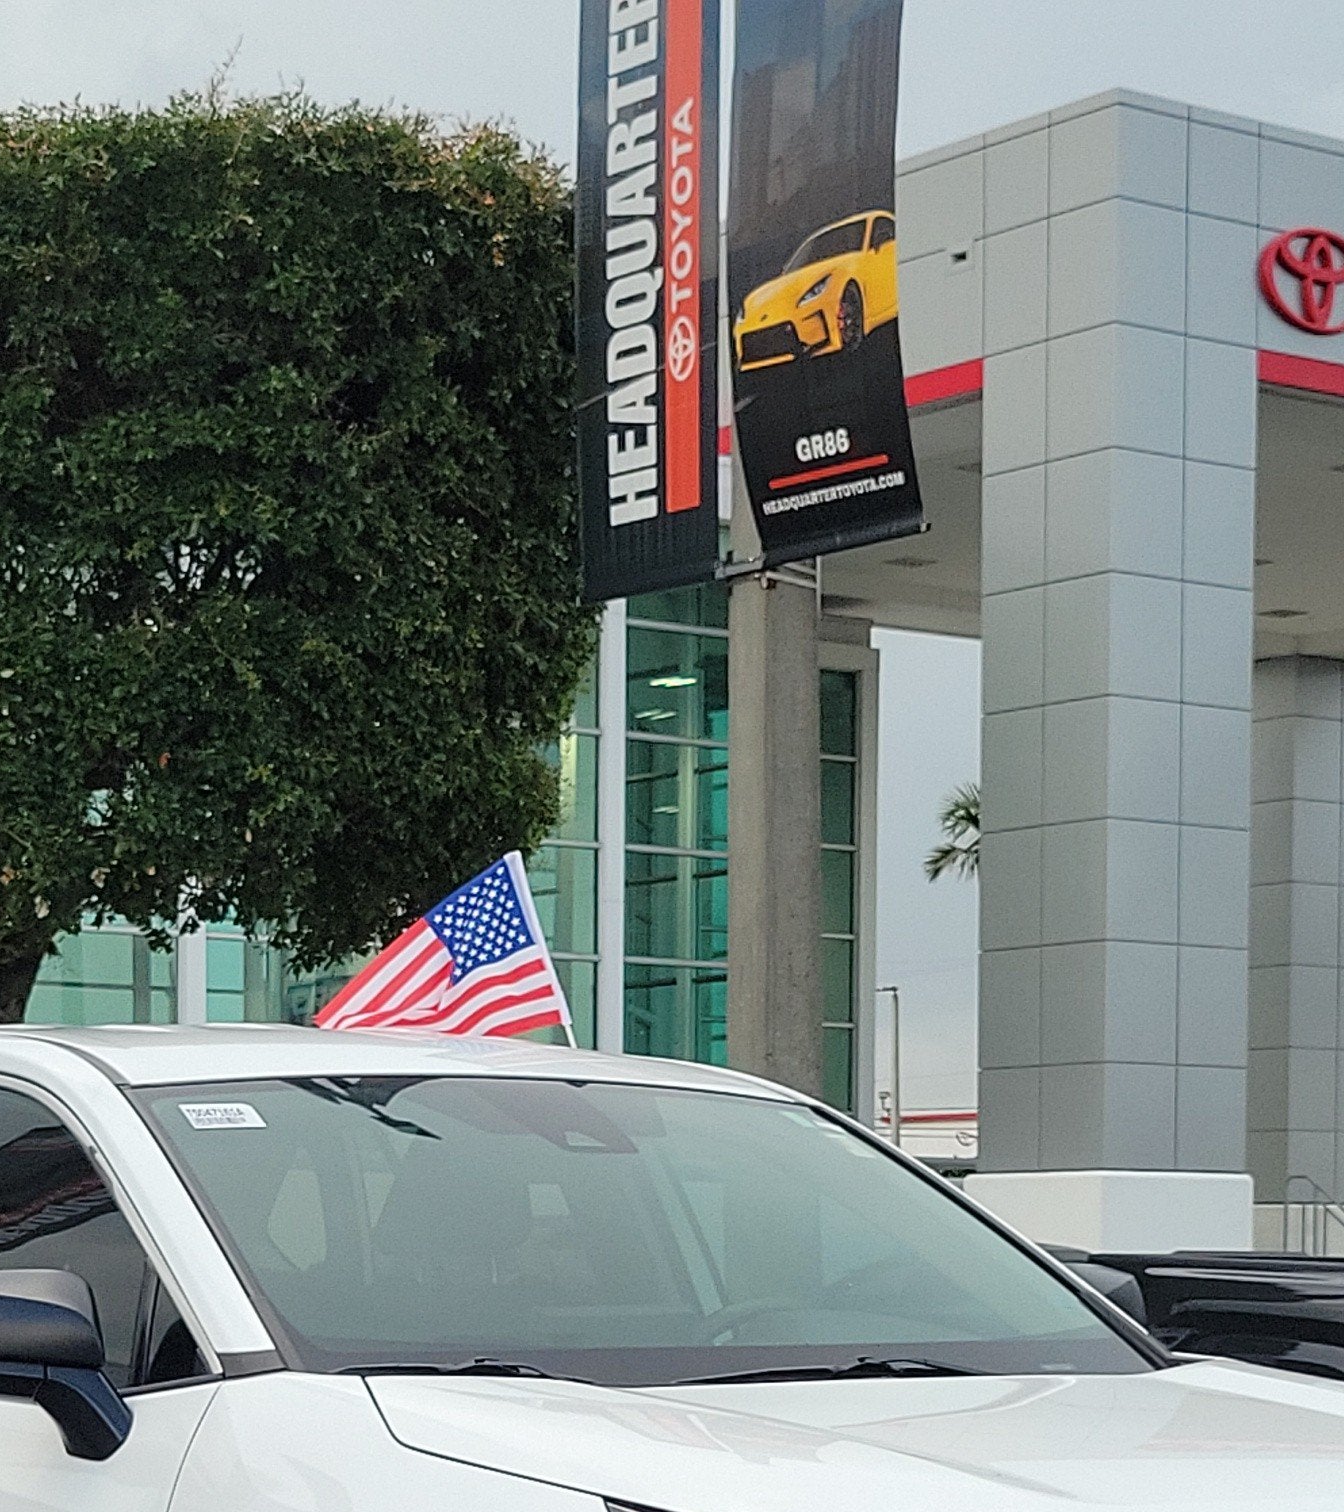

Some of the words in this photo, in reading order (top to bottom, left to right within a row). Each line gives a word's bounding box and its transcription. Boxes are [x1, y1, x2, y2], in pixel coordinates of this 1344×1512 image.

[669, 97, 695, 313] TOYOTA
[795, 427, 851, 463] GR86
[762, 470, 906, 516] HEADQUARTERTOYOTA.COM
